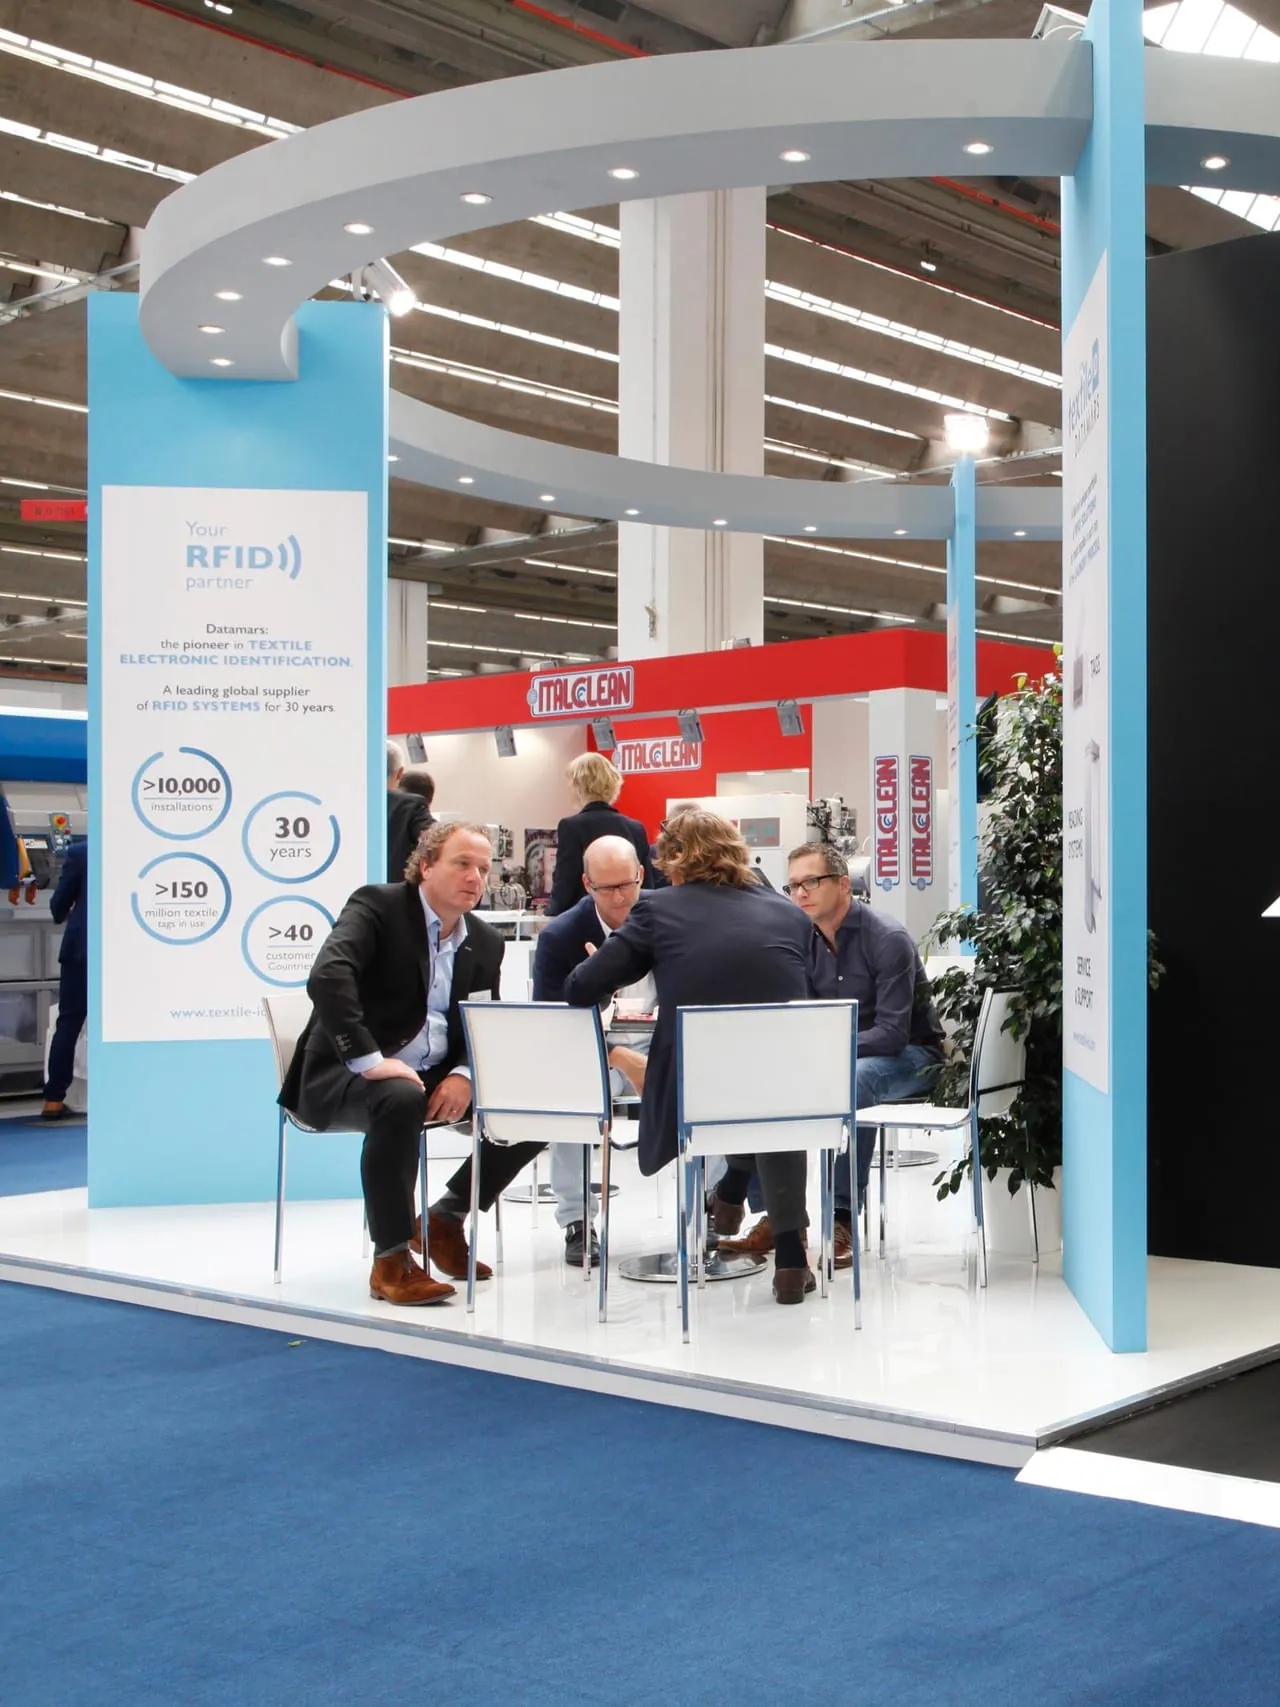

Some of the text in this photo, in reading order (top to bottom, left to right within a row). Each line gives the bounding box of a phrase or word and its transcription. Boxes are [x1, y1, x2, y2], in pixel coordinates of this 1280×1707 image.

[186, 520, 228, 537] Your
[186, 545, 274, 569] RFID
[186, 576, 254, 592] partner
[206, 623, 269, 635] Datamars:
[161, 639, 313, 652] the pioneer in TEXTILE
[120, 654, 218, 666] ELECTRONIC
[162, 685, 311, 699] A leading global supplier
[538, 670, 631, 712] ITALCLEAN
[136, 700, 149, 712] of
[152, 701, 188, 712] RFID
[193, 701, 260, 712] SYSTEMS
[264, 702, 282, 712] for
[286, 702, 300, 712] 30
[621, 739, 699, 771] ITALCLEAN
[143, 777, 221, 796] >10,000
[151, 803, 213, 812] installations
[876, 758, 898, 878] ITALCLEAN
[911, 758, 931, 878] ITALCLEAN
[274, 816, 310, 839] 30
[270, 845, 312, 862] years
[155, 881, 208, 899] >150
[144, 908, 218, 918] million textile
[158, 920, 176, 930] tags
[178, 920, 187, 928] in
[268, 924, 314, 941] >40
[266, 952, 316, 960] customer
